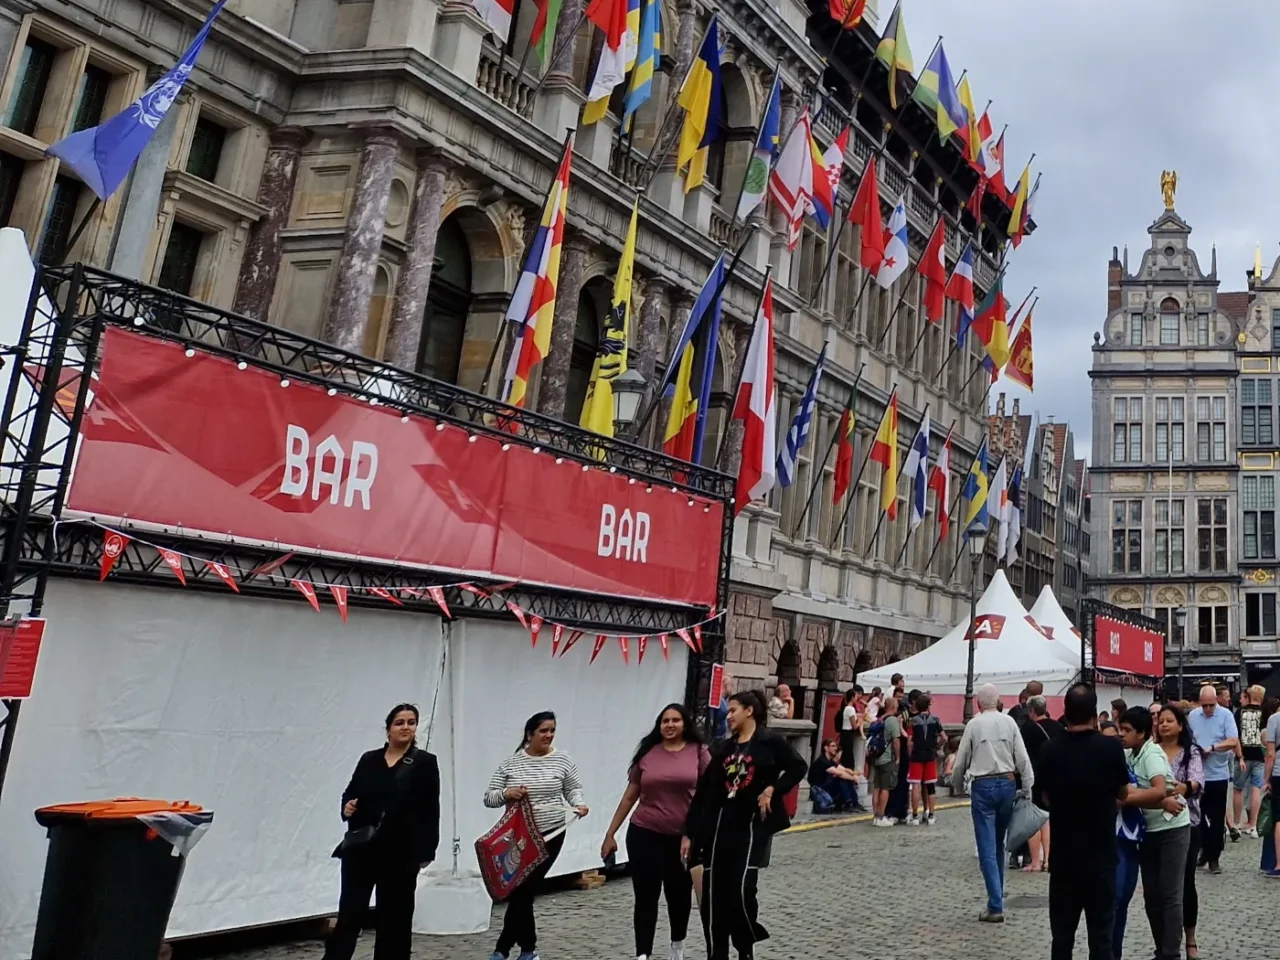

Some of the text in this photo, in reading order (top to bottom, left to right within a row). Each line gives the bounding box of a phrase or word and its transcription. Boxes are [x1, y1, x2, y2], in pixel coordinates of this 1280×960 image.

[280, 423, 378, 511] BAR
[598, 503, 650, 564] BAR
[975, 620, 992, 635] A
